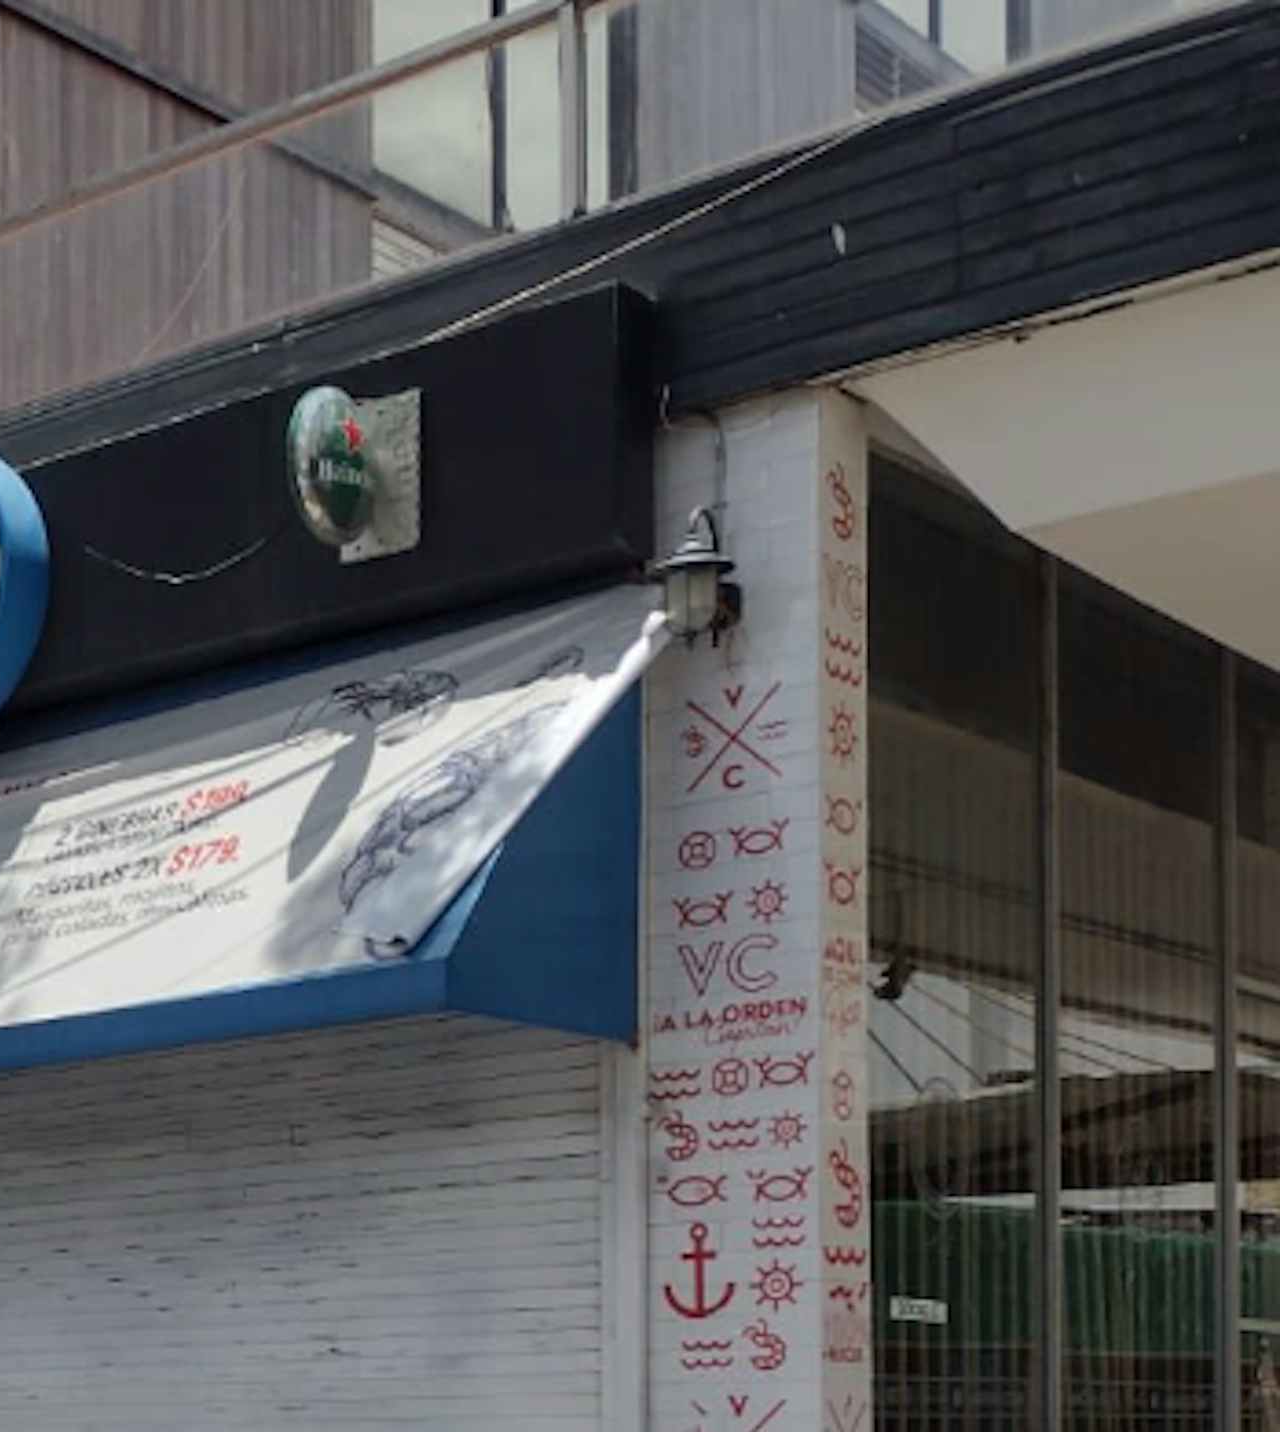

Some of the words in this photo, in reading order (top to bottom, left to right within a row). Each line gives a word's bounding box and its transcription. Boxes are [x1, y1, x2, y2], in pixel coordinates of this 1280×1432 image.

[724, 685, 744, 708] V
[723, 765, 745, 788] C
[677, 933, 778, 996] VC
[685, 1007, 715, 1029] LA
[721, 996, 808, 1024] ORDEN
